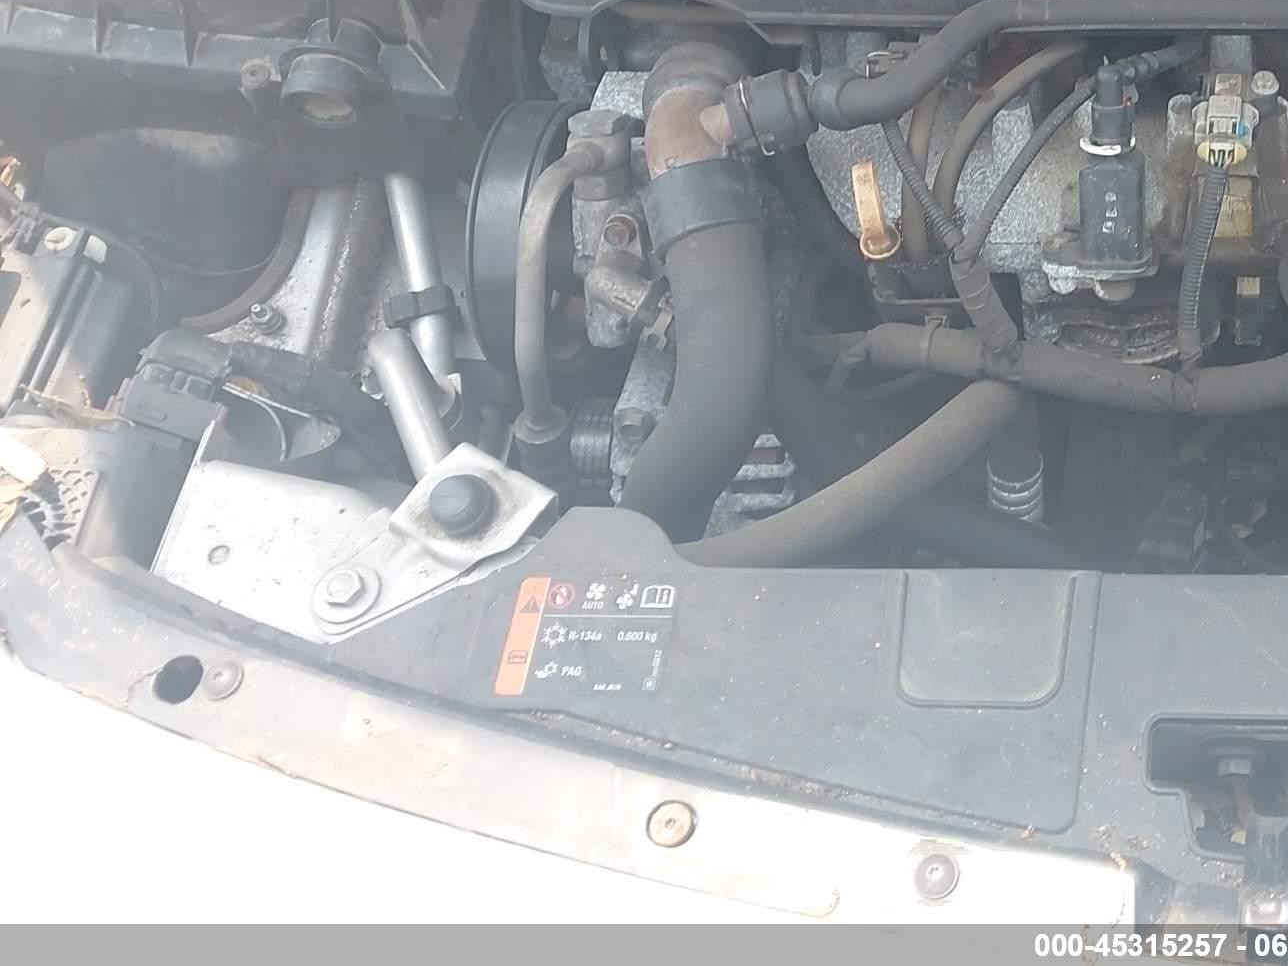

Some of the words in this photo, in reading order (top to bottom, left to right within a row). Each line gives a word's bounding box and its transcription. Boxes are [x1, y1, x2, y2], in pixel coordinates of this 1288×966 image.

[582, 601, 604, 610] AUTO
[568, 630, 603, 642] R-134a
[617, 631, 643, 642] 0.600
[644, 631, 657, 643] kg
